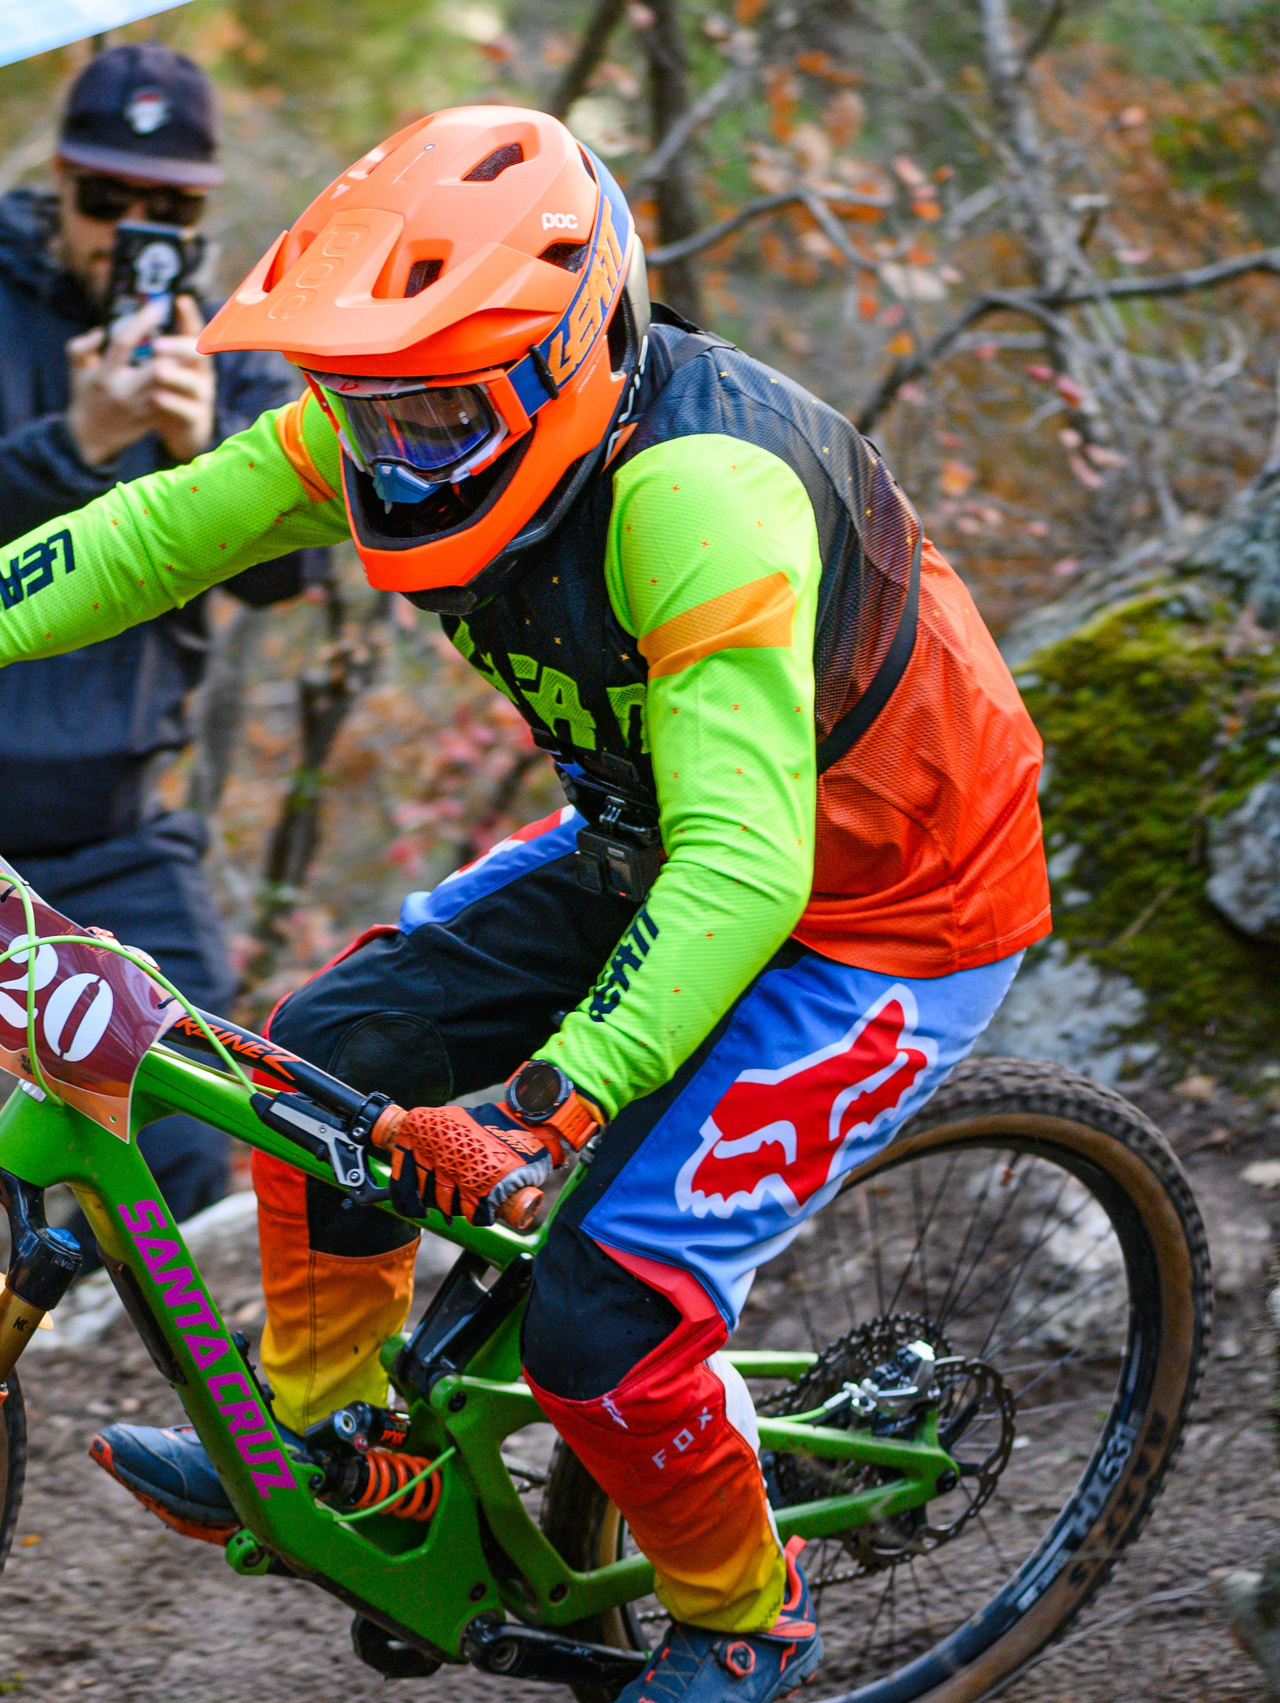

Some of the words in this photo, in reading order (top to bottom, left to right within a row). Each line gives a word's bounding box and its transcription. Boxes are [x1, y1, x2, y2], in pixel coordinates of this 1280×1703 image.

[541, 212, 578, 231] poc
[117, 1199, 230, 1371] SANTA
[206, 1371, 298, 1499] CRUZ
[652, 1406, 713, 1469] FOX
